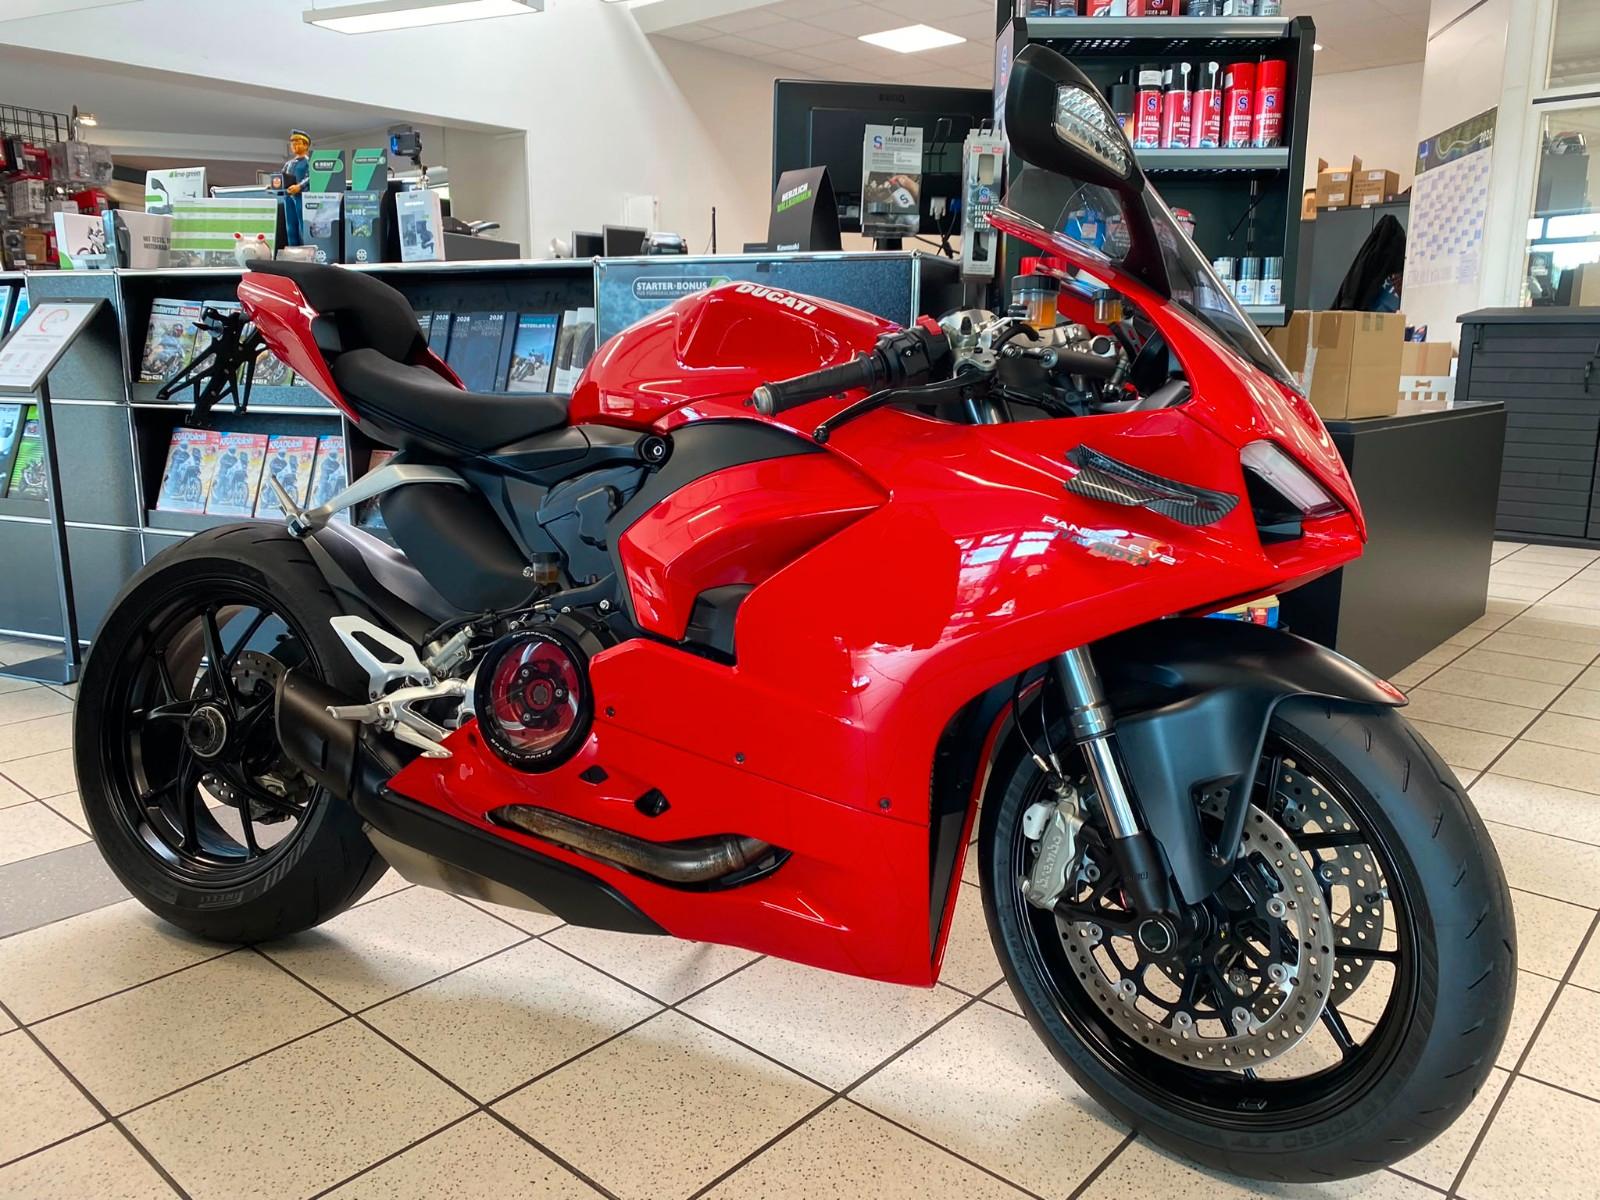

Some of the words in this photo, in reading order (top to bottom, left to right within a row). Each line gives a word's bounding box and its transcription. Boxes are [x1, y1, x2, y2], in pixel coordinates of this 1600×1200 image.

[734, 284, 820, 315] DUCATI
[1041, 514, 1146, 555] PANLE
[1147, 549, 1177, 566] V2
[524, 749, 552, 759] PARTS
[1035, 835, 1062, 889] brembo
